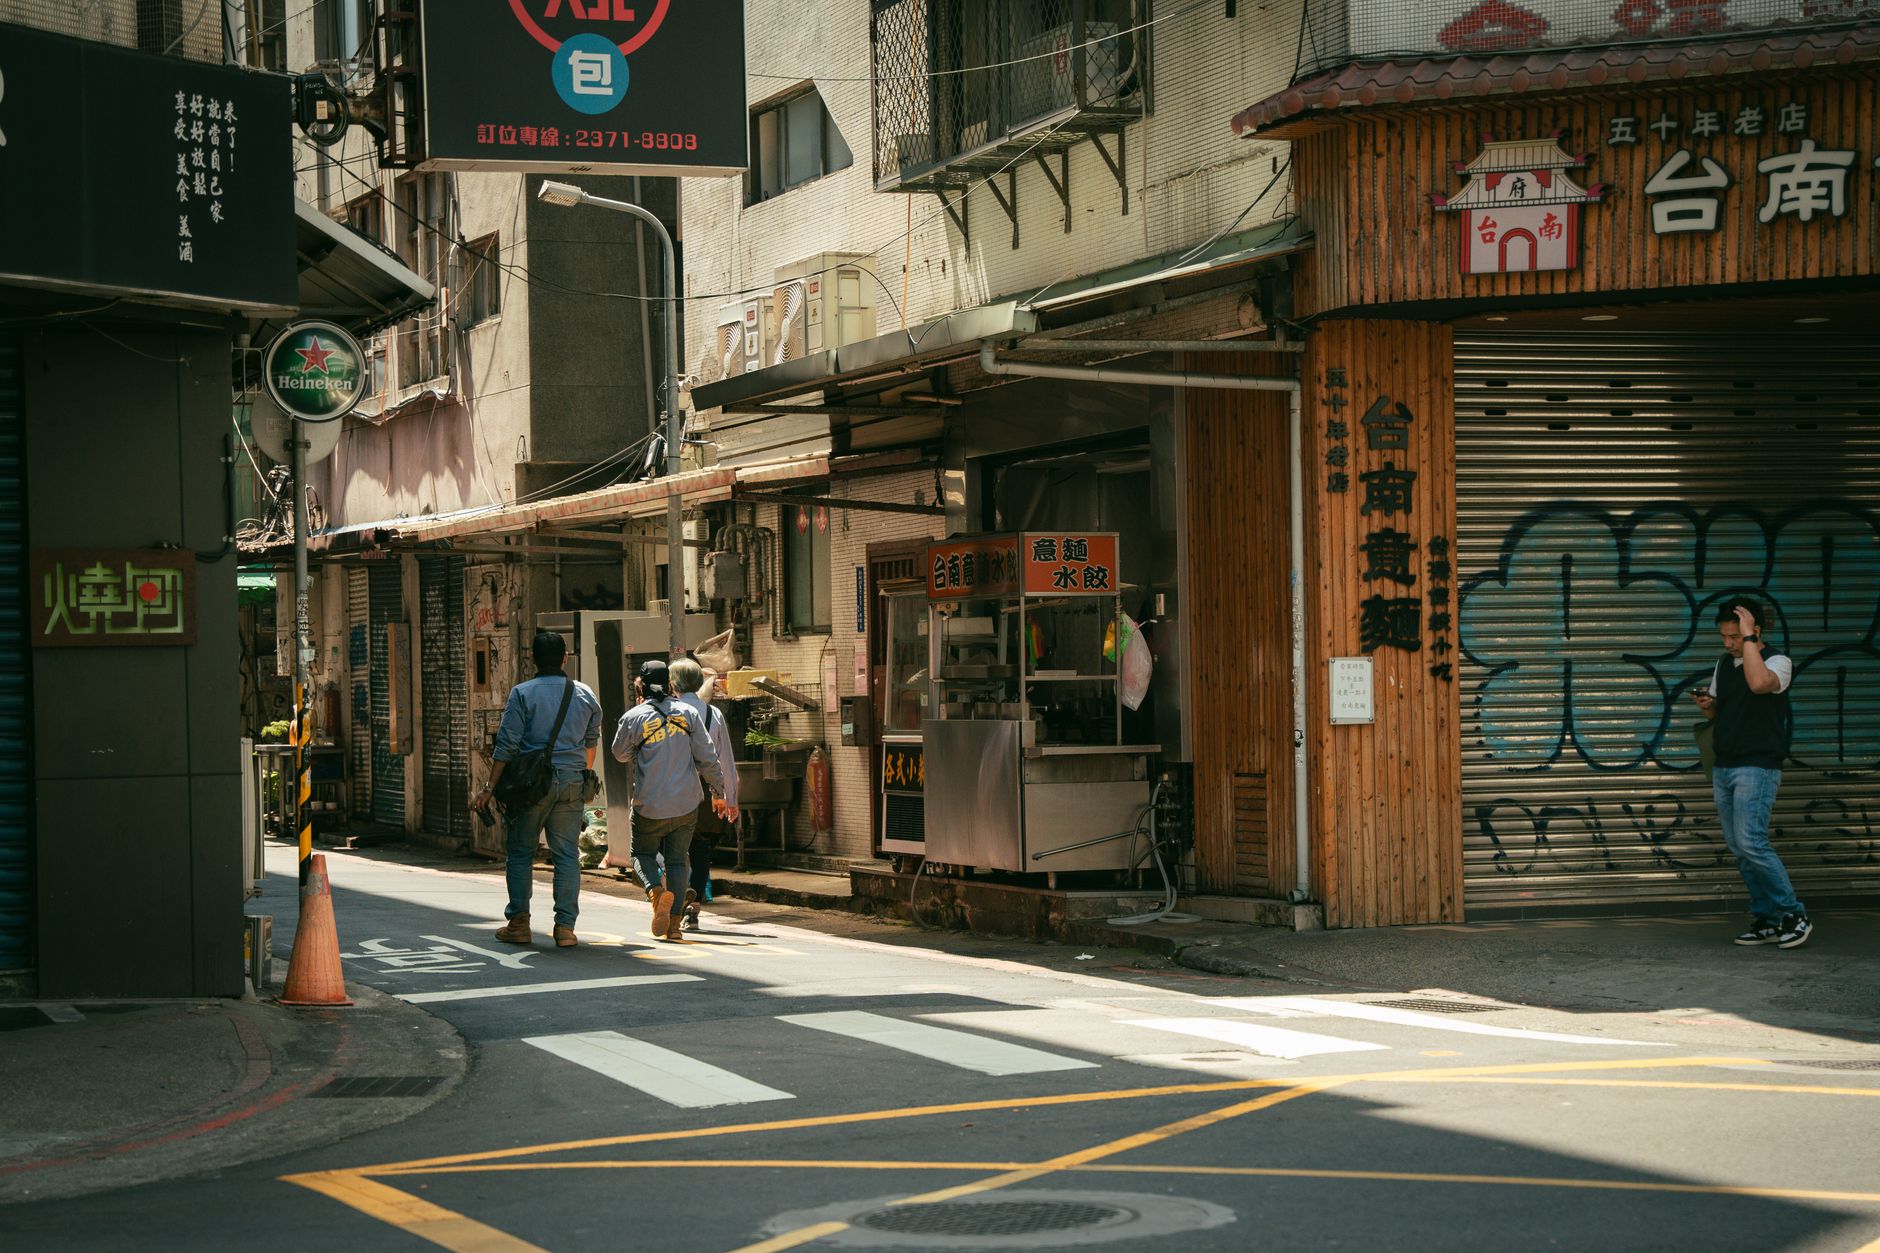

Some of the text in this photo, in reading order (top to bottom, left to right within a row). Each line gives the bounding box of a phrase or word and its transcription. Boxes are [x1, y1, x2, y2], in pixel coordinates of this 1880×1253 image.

[568, 50, 613, 95] 包
[190, 93, 207, 196] 好好放鬆
[1608, 103, 1806, 145] 五十年老店
[174, 89, 193, 263] 享受 美食 美酒
[206, 98, 224, 224] 就當自己家
[1508, 176, 1527, 199] 府
[1644, 139, 1880, 234] 台南
[278, 376, 352, 391] Heineken
[1324, 368, 1349, 493] 五十年老店
[1032, 538, 1089, 563] 意麵
[1359, 396, 1422, 652] 台南意麵
[1052, 565, 1110, 590] 水餃
